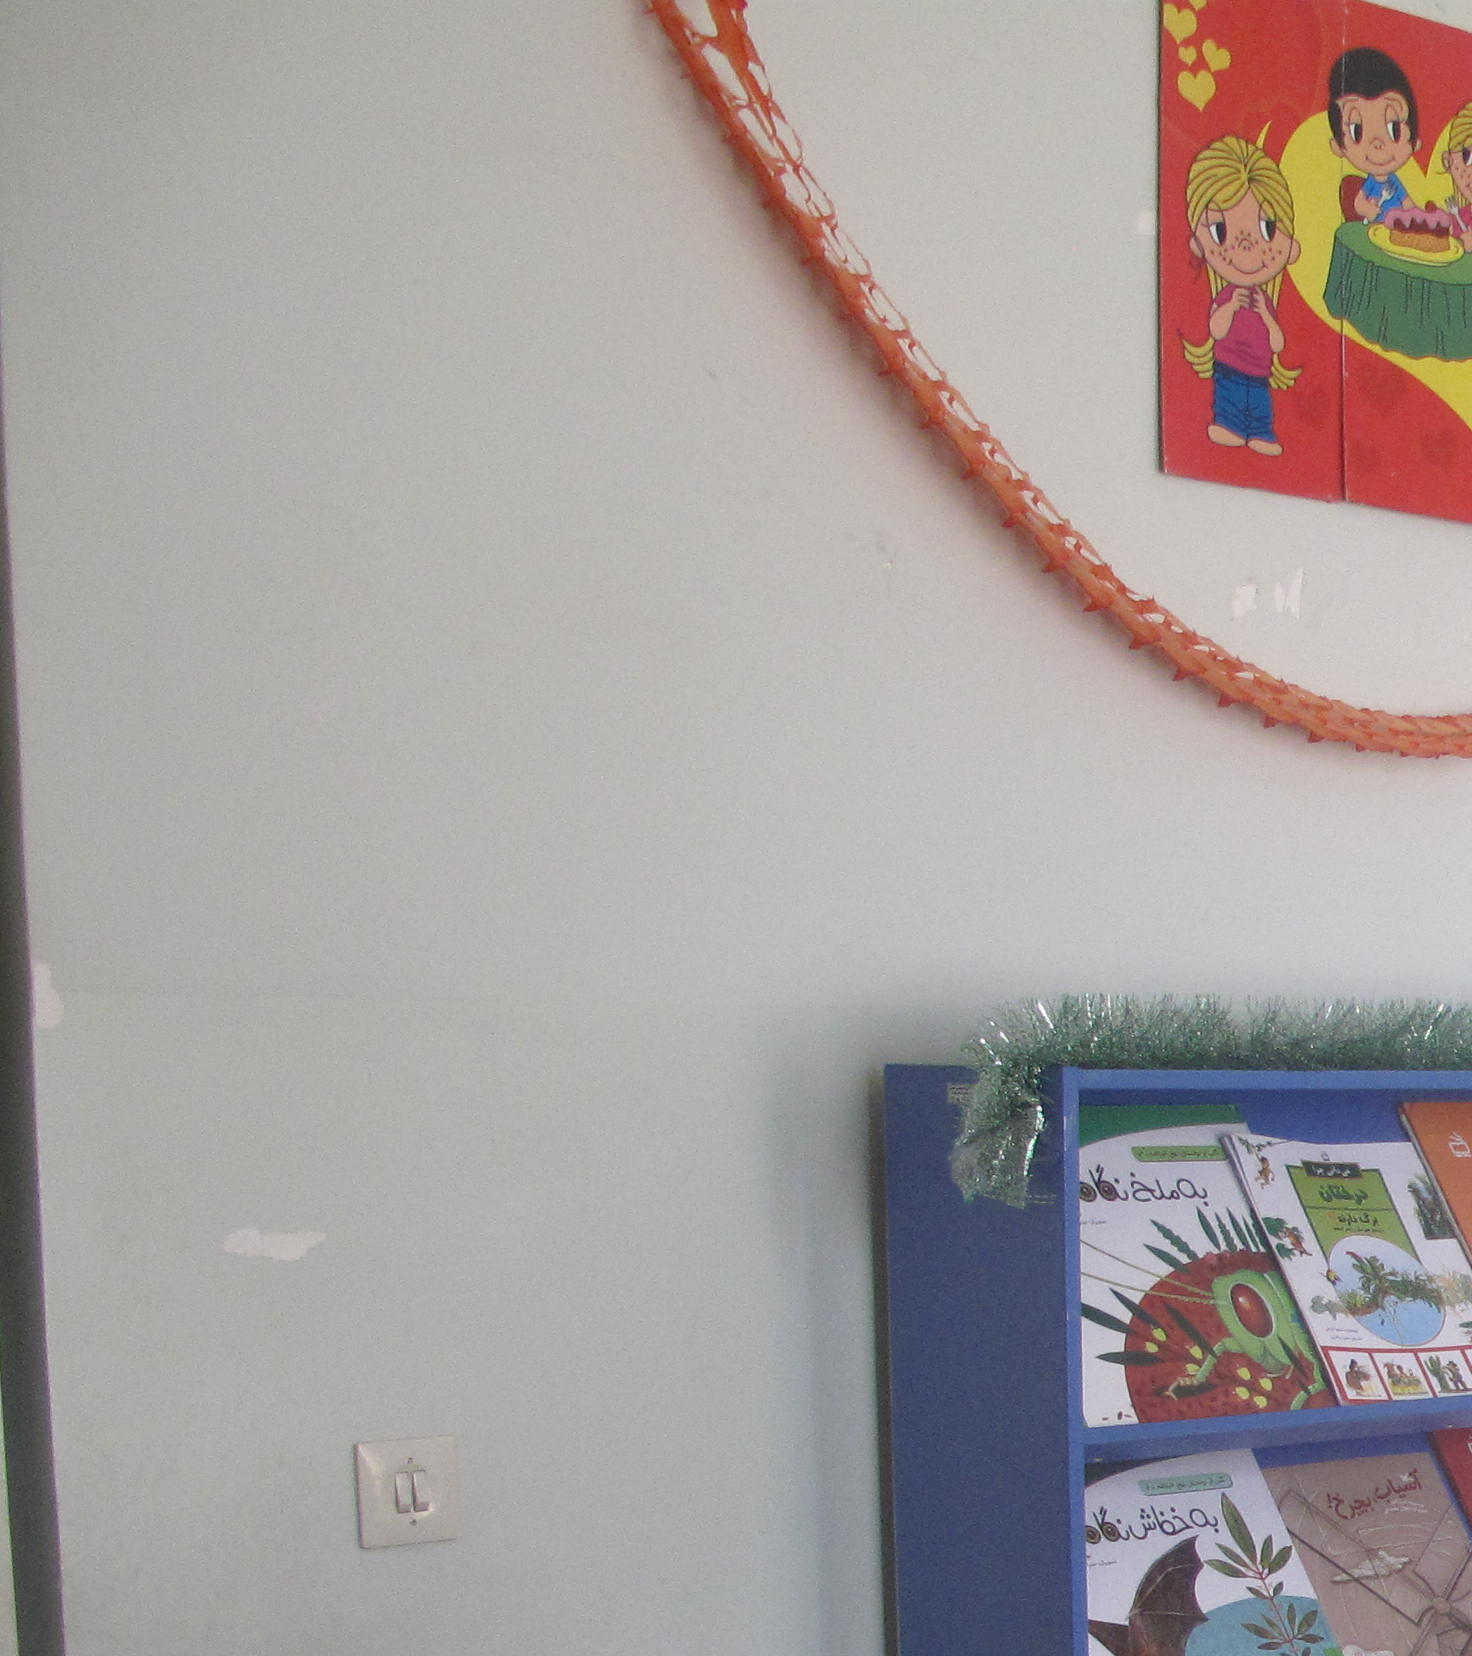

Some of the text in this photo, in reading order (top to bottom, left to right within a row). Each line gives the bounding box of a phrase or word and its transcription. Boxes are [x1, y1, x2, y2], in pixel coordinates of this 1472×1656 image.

[1130, 1172, 1181, 1202] ملخ
[1176, 1177, 1209, 1207] به
[1128, 1504, 1195, 1540] خفاش
[1189, 1507, 1220, 1534] به
